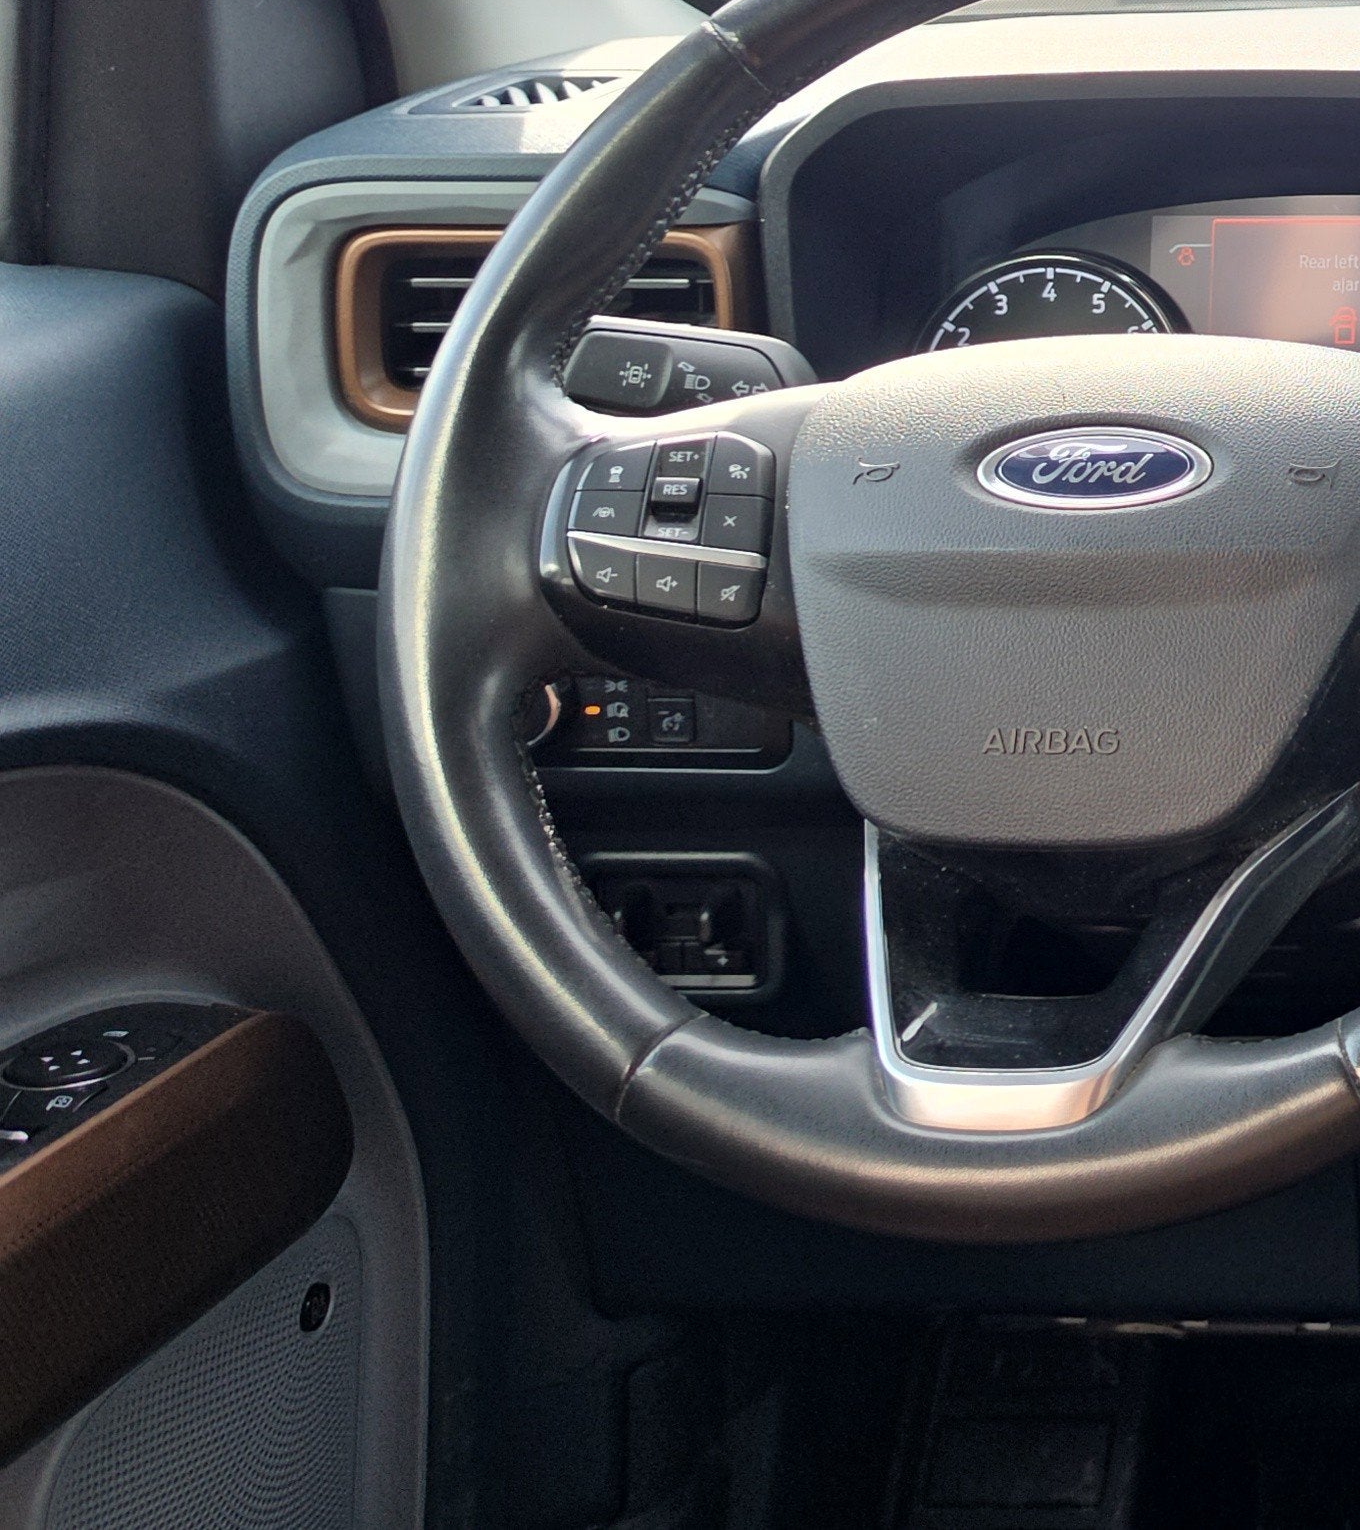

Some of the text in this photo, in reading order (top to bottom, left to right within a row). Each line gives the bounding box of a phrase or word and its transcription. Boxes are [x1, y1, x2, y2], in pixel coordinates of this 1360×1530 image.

[1301, 256, 1331, 269] Rear
[1335, 255, 1359, 269] left
[1041, 282, 1057, 302] 4
[1332, 280, 1360, 294] ajar
[994, 294, 1008, 315] 3
[1092, 293, 1106, 314] 5
[668, 449, 700, 463] SET+
[1032, 443, 1154, 485] Ford
[662, 483, 688, 496] RES
[656, 526, 689, 539] SET-
[982, 726, 1122, 756] AIRBAG
